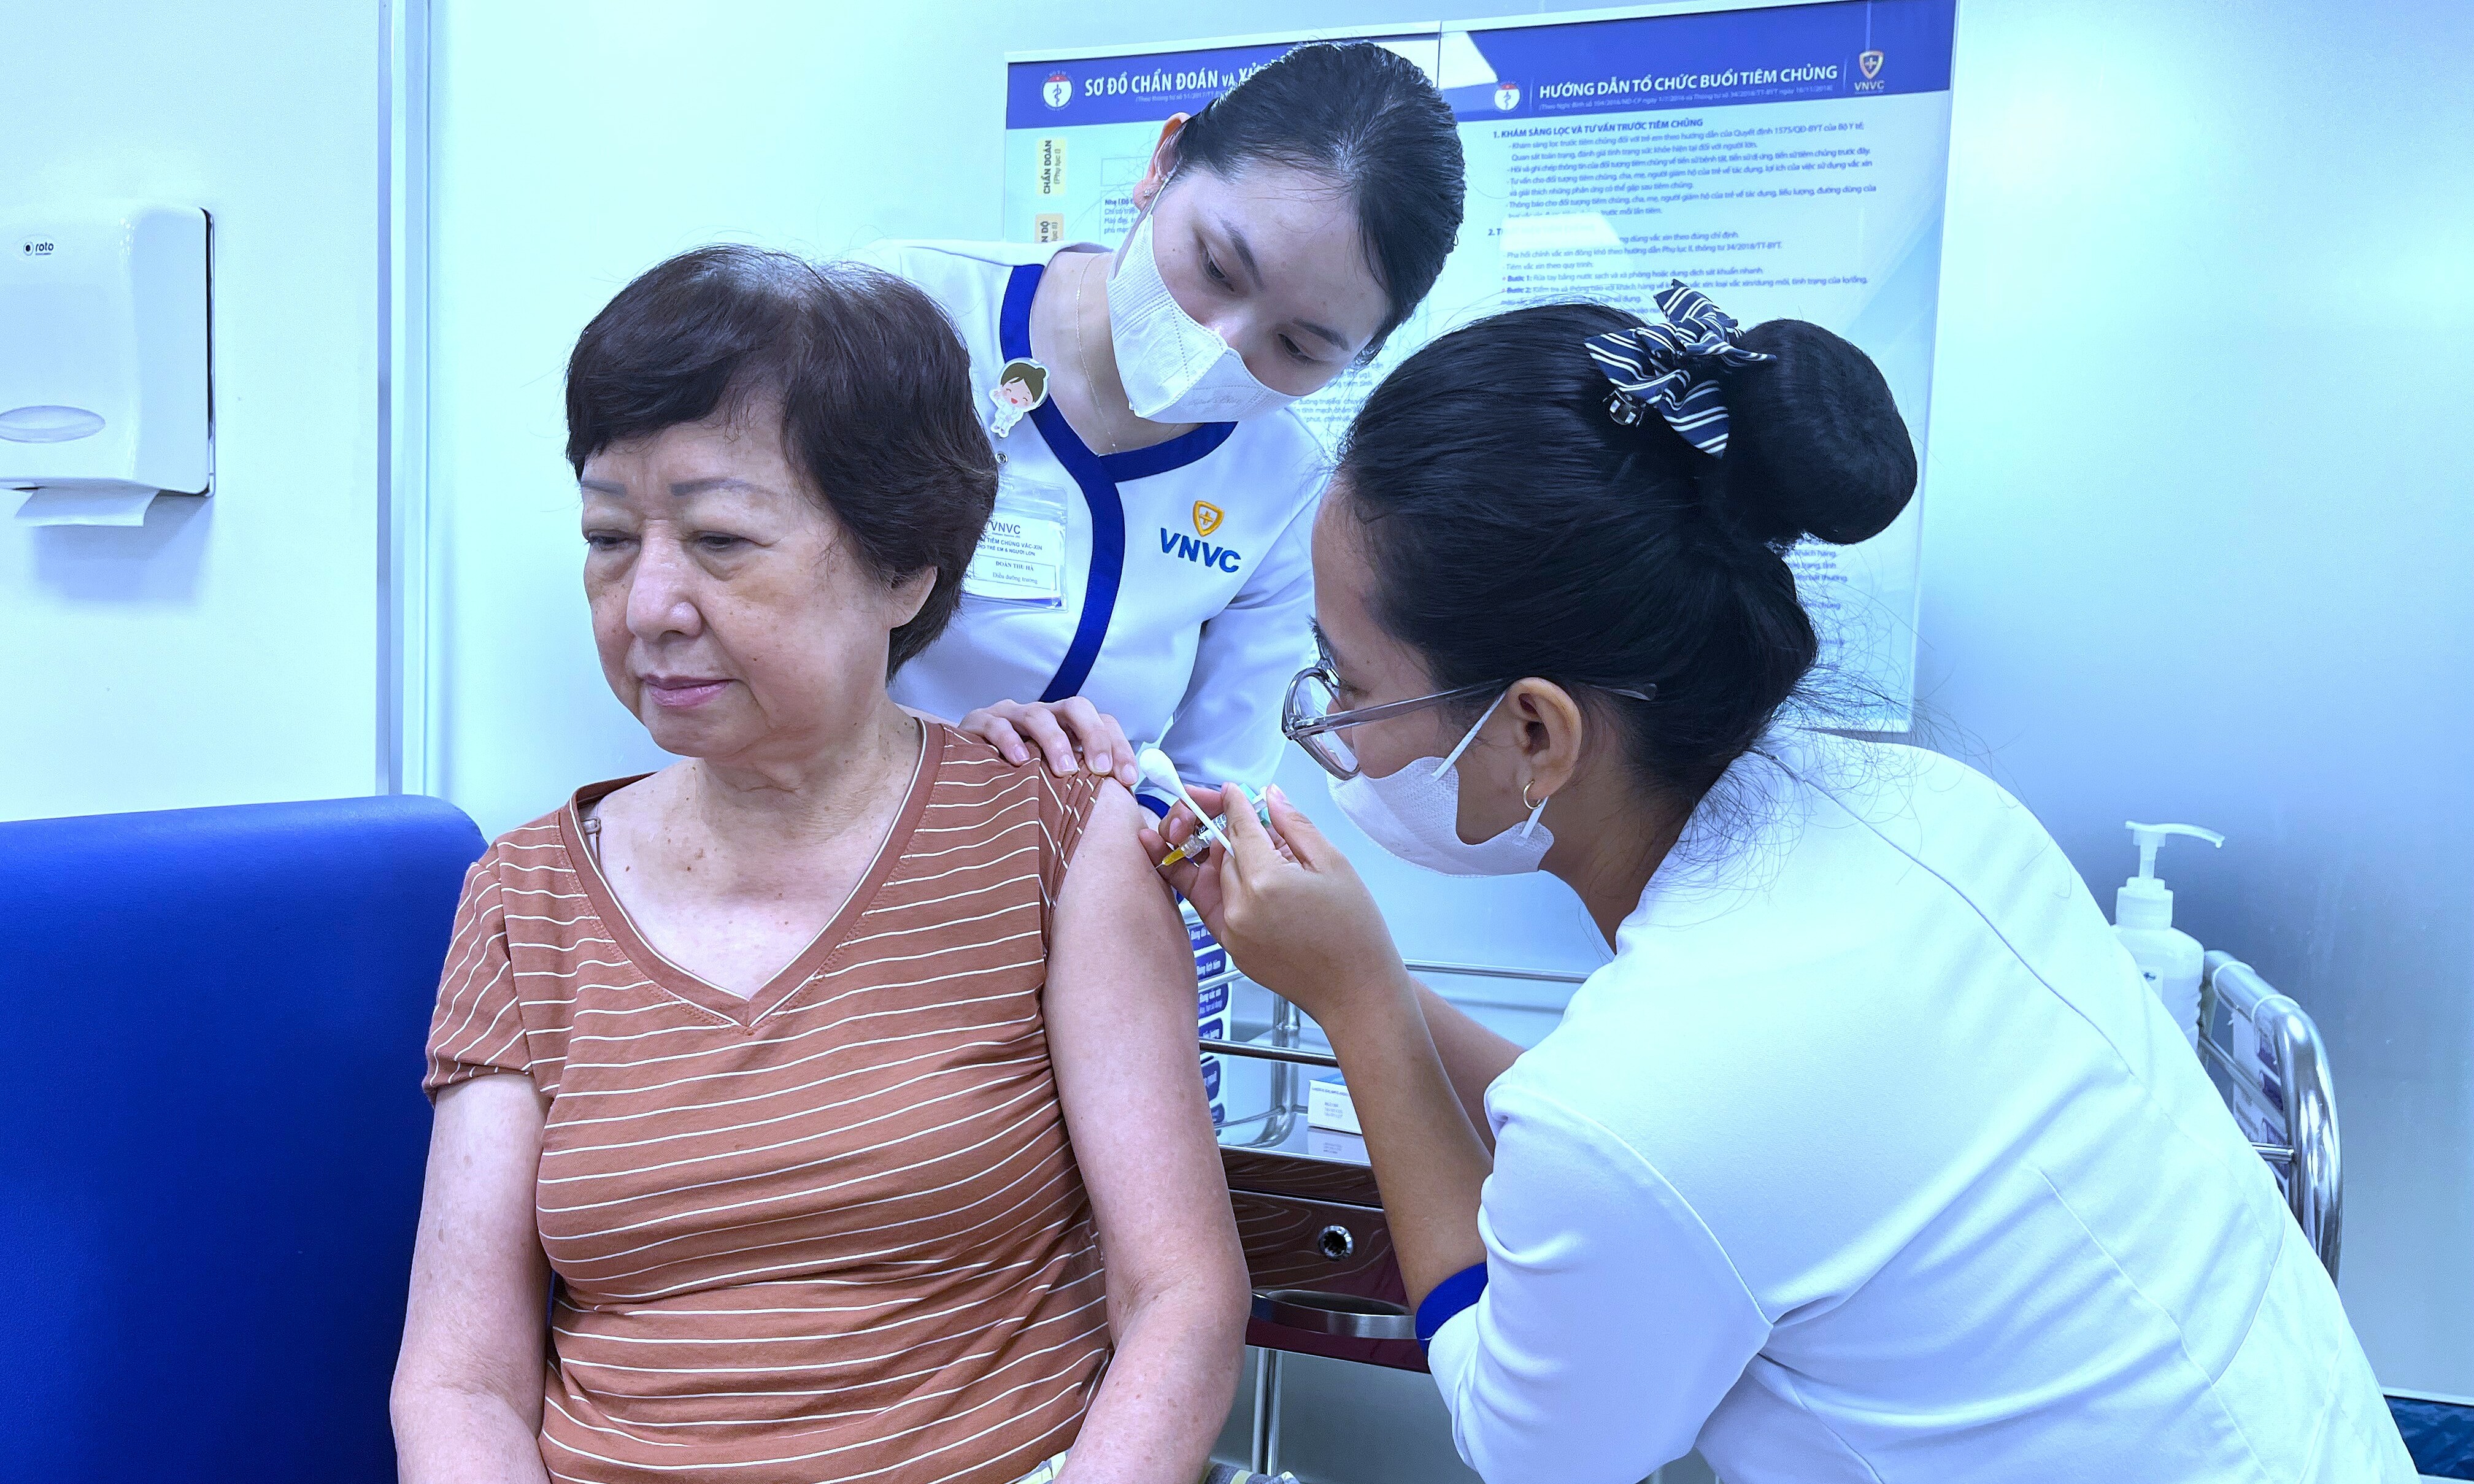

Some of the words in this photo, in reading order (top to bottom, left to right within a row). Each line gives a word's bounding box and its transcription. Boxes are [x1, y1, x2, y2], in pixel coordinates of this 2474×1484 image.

[1085, 77, 1104, 96] SƠ
[1107, 72, 1127, 95] ĐỒ
[1131, 68, 1171, 93] CHẨN
[1176, 67, 1218, 91] ĐOÁN
[1540, 82, 1594, 98] HƯỚNG
[1598, 77, 1629, 95] DẪN
[1632, 75, 1652, 91] TỔ
[1654, 74, 1696, 90] CHỨC
[1701, 69, 1738, 88] BUỔI
[1740, 69, 1777, 85] TIÊM
[1781, 63, 1837, 82] CHỦNG
[1854, 80, 1884, 91] VNVC
[1501, 129, 1526, 137] KHÁM
[1554, 127, 1570, 136] LỌC
[1649, 120, 1668, 129] TIÊM
[1041, 169, 1051, 194] CHẨN
[990, 521, 1020, 534] VNVC
[1160, 528, 1241, 573] VNVC
